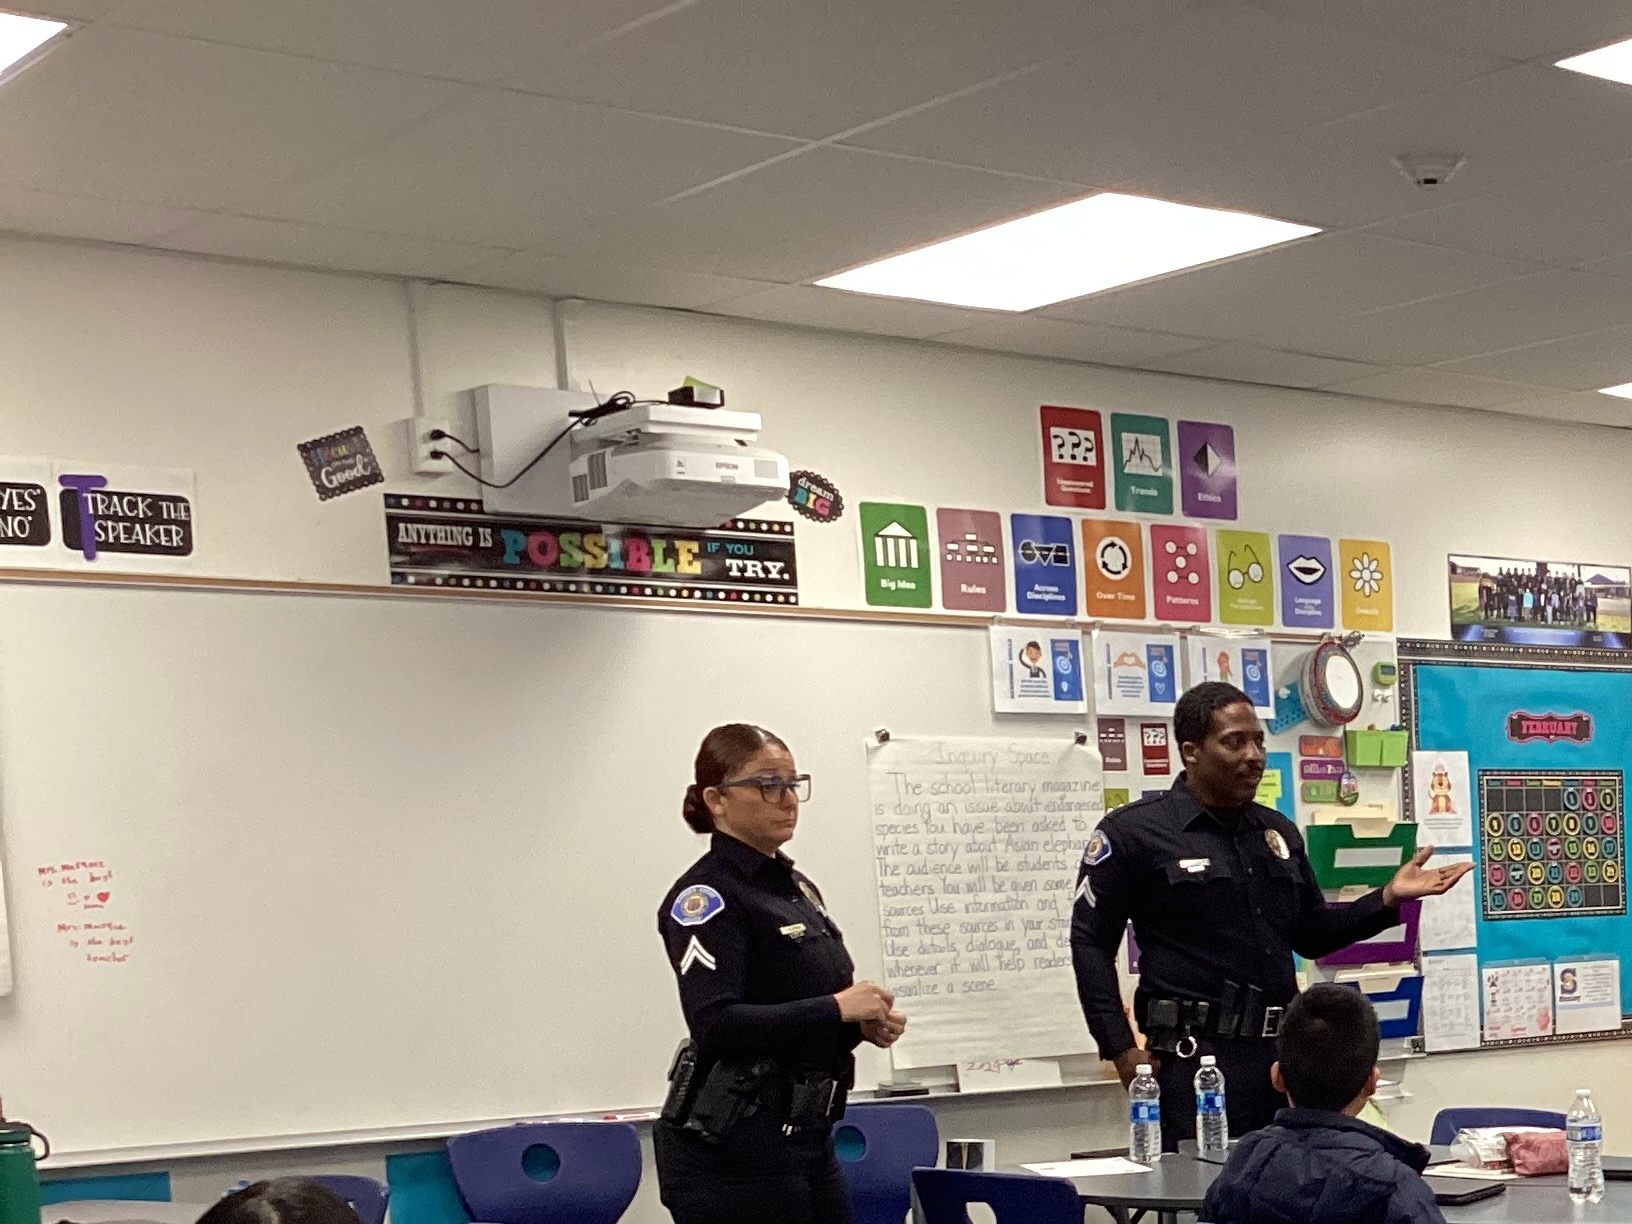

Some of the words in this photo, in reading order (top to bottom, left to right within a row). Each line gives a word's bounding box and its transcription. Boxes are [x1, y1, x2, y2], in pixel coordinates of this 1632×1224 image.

[321, 454, 371, 488] Good
[716, 462, 738, 470] EPSON
[794, 487, 831, 515] BIG
[798, 477, 834, 501] dream
[83, 493, 152, 517] TRACK
[159, 502, 190, 520] THE
[94, 520, 183, 546] SPEAKER
[398, 523, 473, 546] ANYTHING
[479, 528, 493, 547] IS
[501, 529, 701, 574] POSSIBLE
[707, 542, 720, 553] IF
[726, 543, 754, 555] YOU
[725, 559, 789, 580] TRY.
[880, 579, 895, 590] Big
[960, 584, 987, 594] Rules
[1096, 591, 1116, 601] Over
[1117, 592, 1136, 601] Time
[1166, 595, 1199, 605] Patterns
[936, 742, 998, 773] Inquiry
[1010, 742, 1050, 769] Space
[886, 772, 922, 795] The
[930, 772, 976, 795] school
[984, 772, 1036, 801] literary
[875, 803, 884, 815] is
[938, 802, 958, 815] an
[965, 800, 999, 814] issue
[1005, 796, 1040, 812] about
[926, 817, 944, 834] You
[953, 817, 984, 837] have
[995, 816, 1024, 834] been
[1032, 815, 1066, 832] asked
[1072, 818, 1087, 832] to
[876, 840, 909, 857] write
[912, 844, 922, 855] a
[927, 839, 957, 863] story
[965, 838, 998, 854] about
[1004, 837, 1039, 852] Asian
[876, 857, 900, 877] The
[906, 855, 962, 875] audience
[967, 855, 989, 874] will
[995, 854, 1009, 873] be
[1017, 853, 1067, 872] students
[880, 879, 934, 898] teachers
[941, 876, 959, 893] You
[966, 874, 986, 893] will
[992, 874, 1007, 894] be
[1043, 879, 1073, 891] some
[883, 902, 924, 917] sources
[929, 897, 956, 915] Use
[965, 893, 1029, 914] information
[1037, 892, 1059, 912] and
[883, 919, 910, 938] from
[916, 918, 950, 936] these
[959, 920, 999, 934] sources
[1021, 918, 1042, 937] your
[884, 938, 910, 958] Use
[1027, 933, 1047, 950] and
[887, 958, 938, 978] whenever
[950, 958, 960, 974] it
[969, 953, 990, 973] will
[999, 953, 1025, 973] help
[947, 983, 954, 993] a
